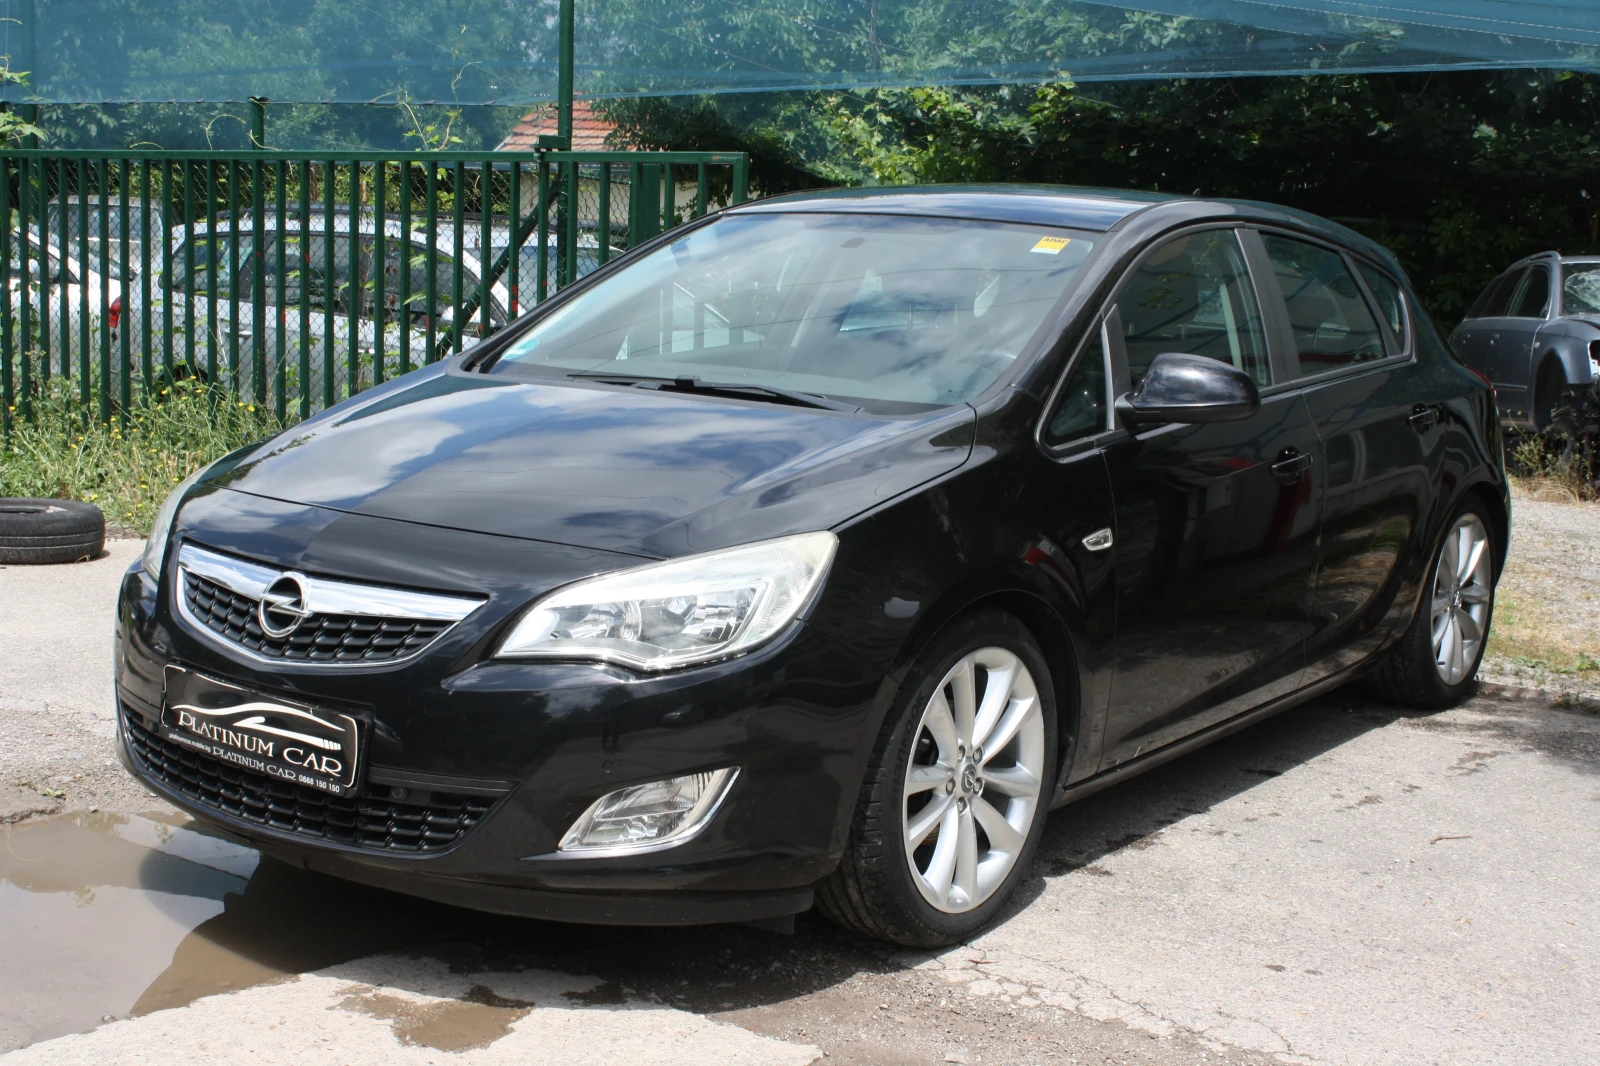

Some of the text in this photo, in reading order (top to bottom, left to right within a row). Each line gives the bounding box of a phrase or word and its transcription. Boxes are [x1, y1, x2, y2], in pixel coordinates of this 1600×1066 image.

[178, 711, 342, 777] PLATINUM CAR
[212, 746, 265, 771] PLATINUM
[266, 765, 296, 780] CAR
[298, 774, 314, 786] 0888
[315, 779, 327, 789] 150
[328, 783, 340, 793] 150
